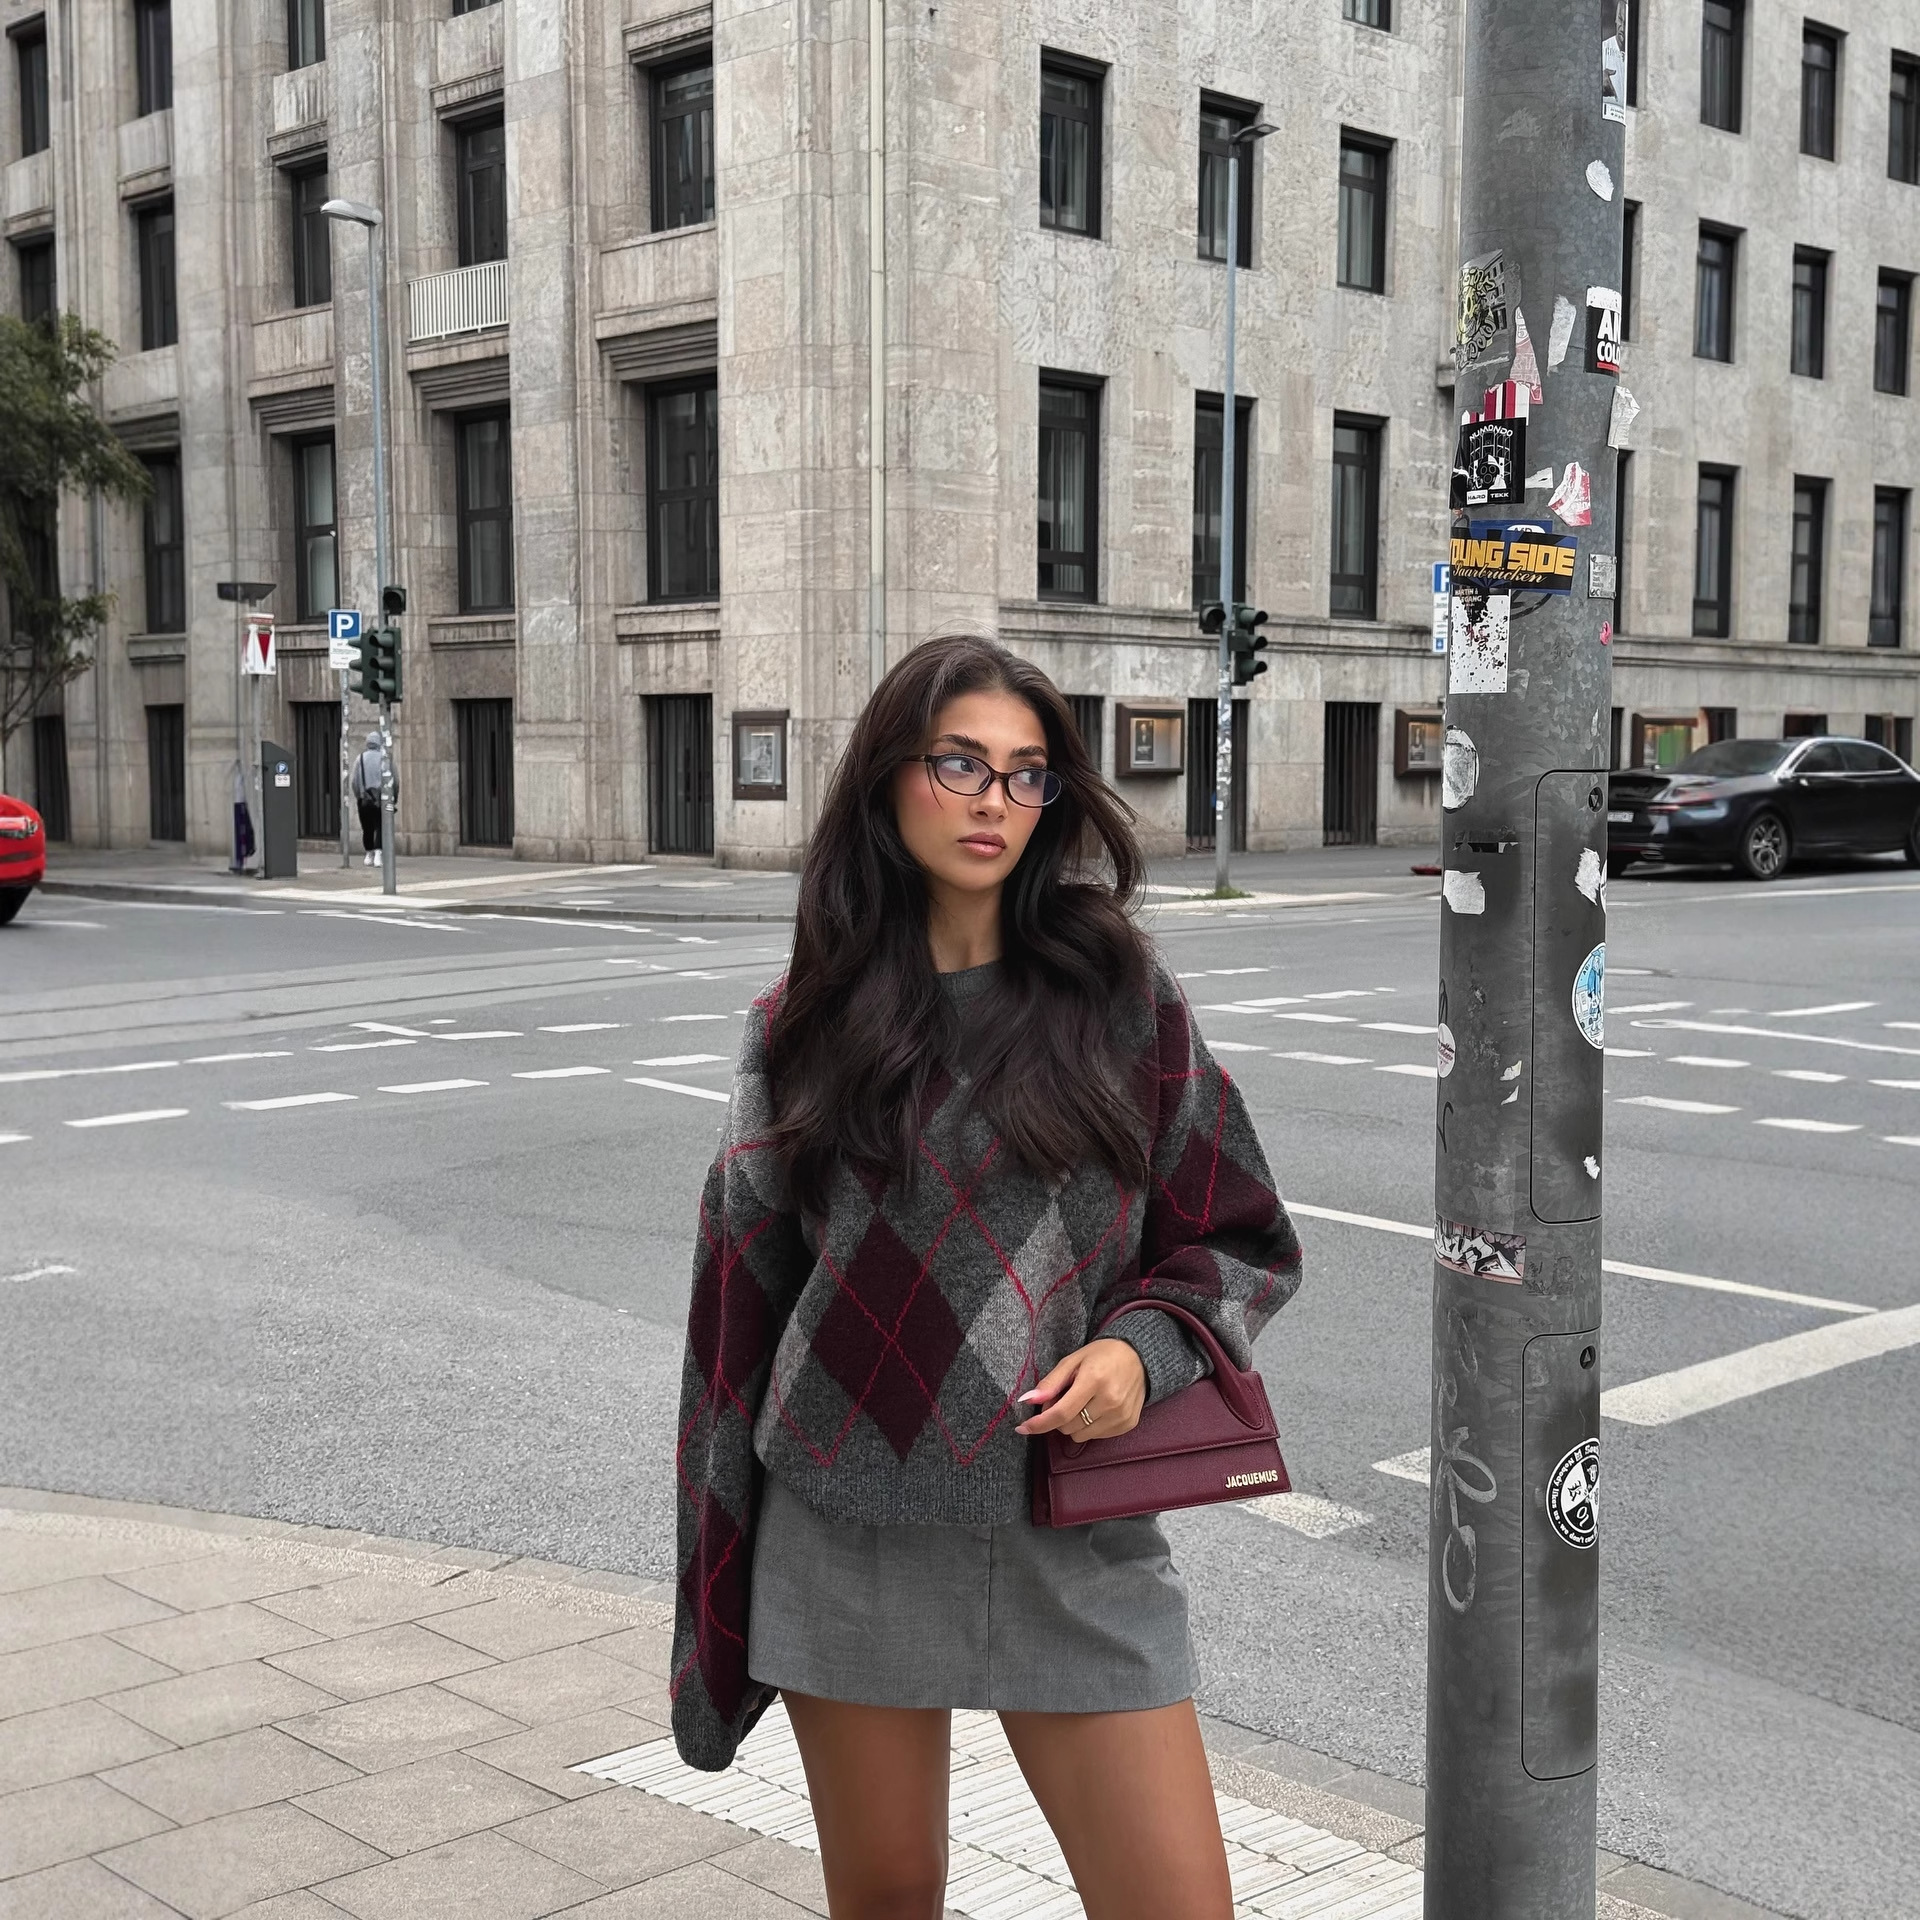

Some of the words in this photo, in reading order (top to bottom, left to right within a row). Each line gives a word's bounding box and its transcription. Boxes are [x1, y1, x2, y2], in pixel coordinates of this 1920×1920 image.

[1469, 424, 1514, 442] NUMONDO
[1450, 538, 1505, 569] OUNG
[1507, 542, 1576, 577] SIDE
[1452, 561, 1547, 583] Saarbrücken
[336, 613, 354, 638] P
[1225, 1469, 1279, 1489] JACQUEMUS
[1553, 1457, 1575, 1487] Nobody
[1559, 1523, 1569, 1535] we
